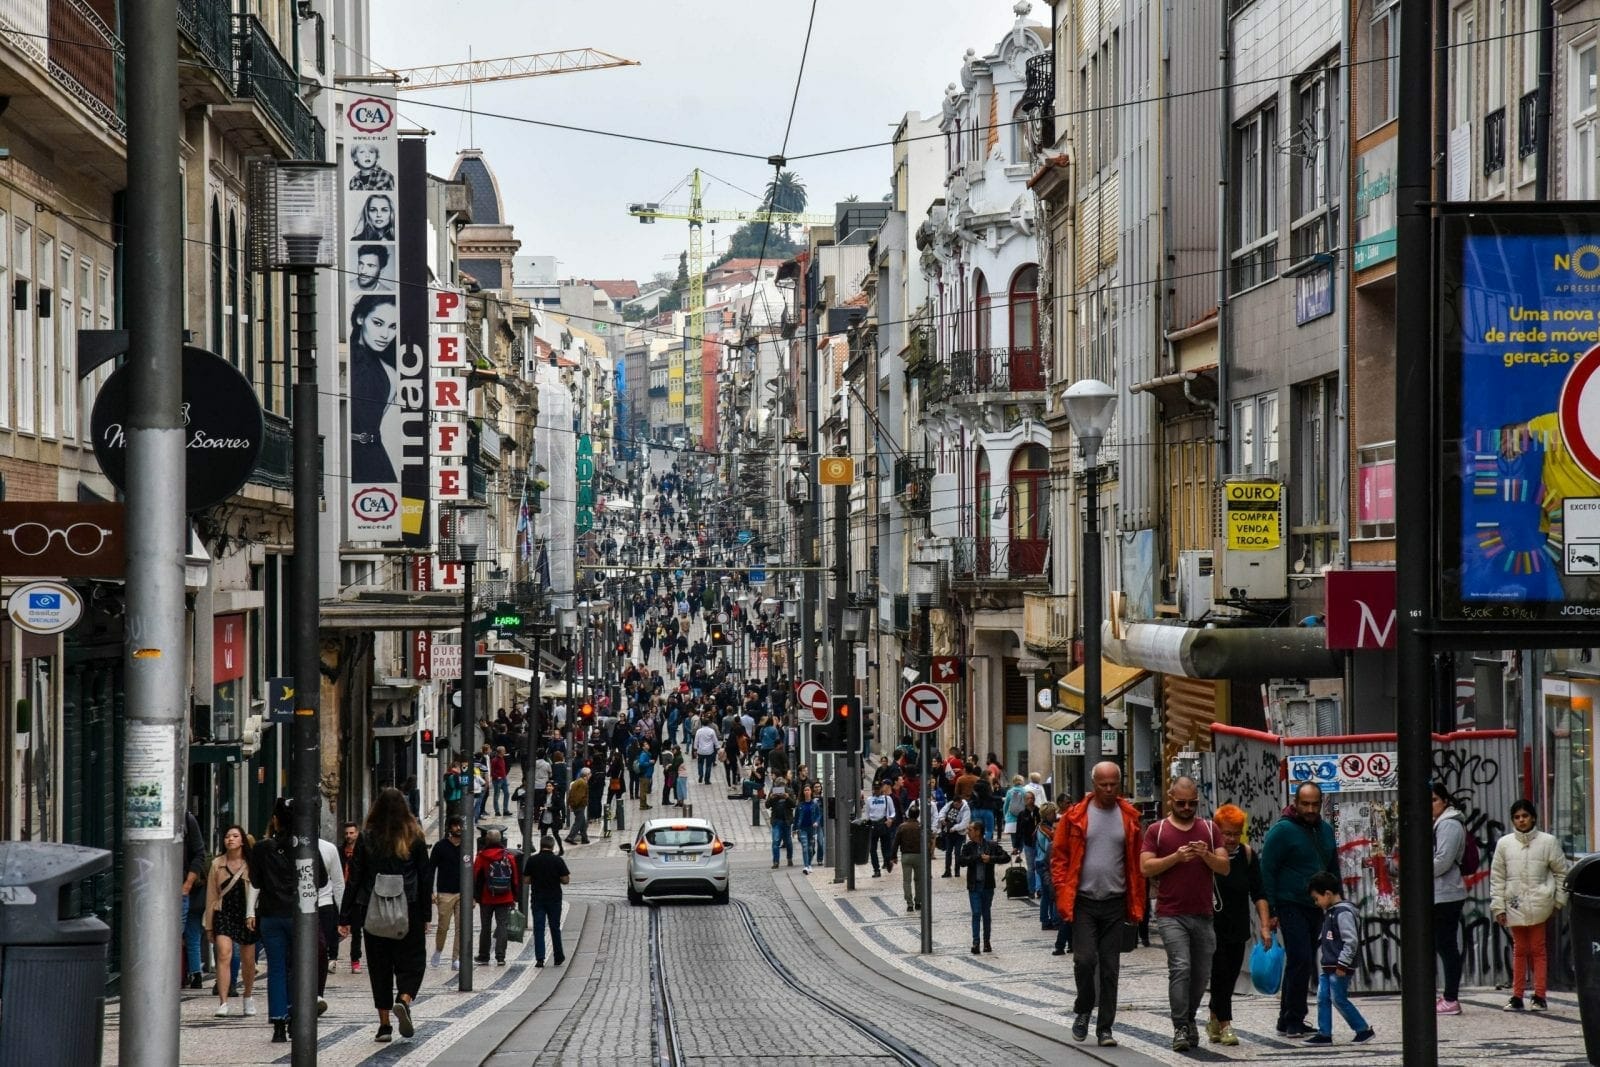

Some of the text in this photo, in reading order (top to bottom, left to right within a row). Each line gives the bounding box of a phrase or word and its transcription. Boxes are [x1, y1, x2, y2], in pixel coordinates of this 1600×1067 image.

[355, 107, 385, 123] C&A
[1556, 284, 1600, 293] APRESE
[1509, 306, 1594, 321] Uma nova
[1484, 327, 1506, 342] de
[1509, 327, 1547, 342] rede
[1503, 348, 1570, 367] geração
[186, 430, 250, 449] Soares
[1232, 487, 1275, 499] OURO
[360, 496, 390, 513] C&A
[1231, 513, 1275, 521] COMPRA
[1236, 525, 1270, 533] VENDA
[1235, 536, 1270, 545] TROCA
